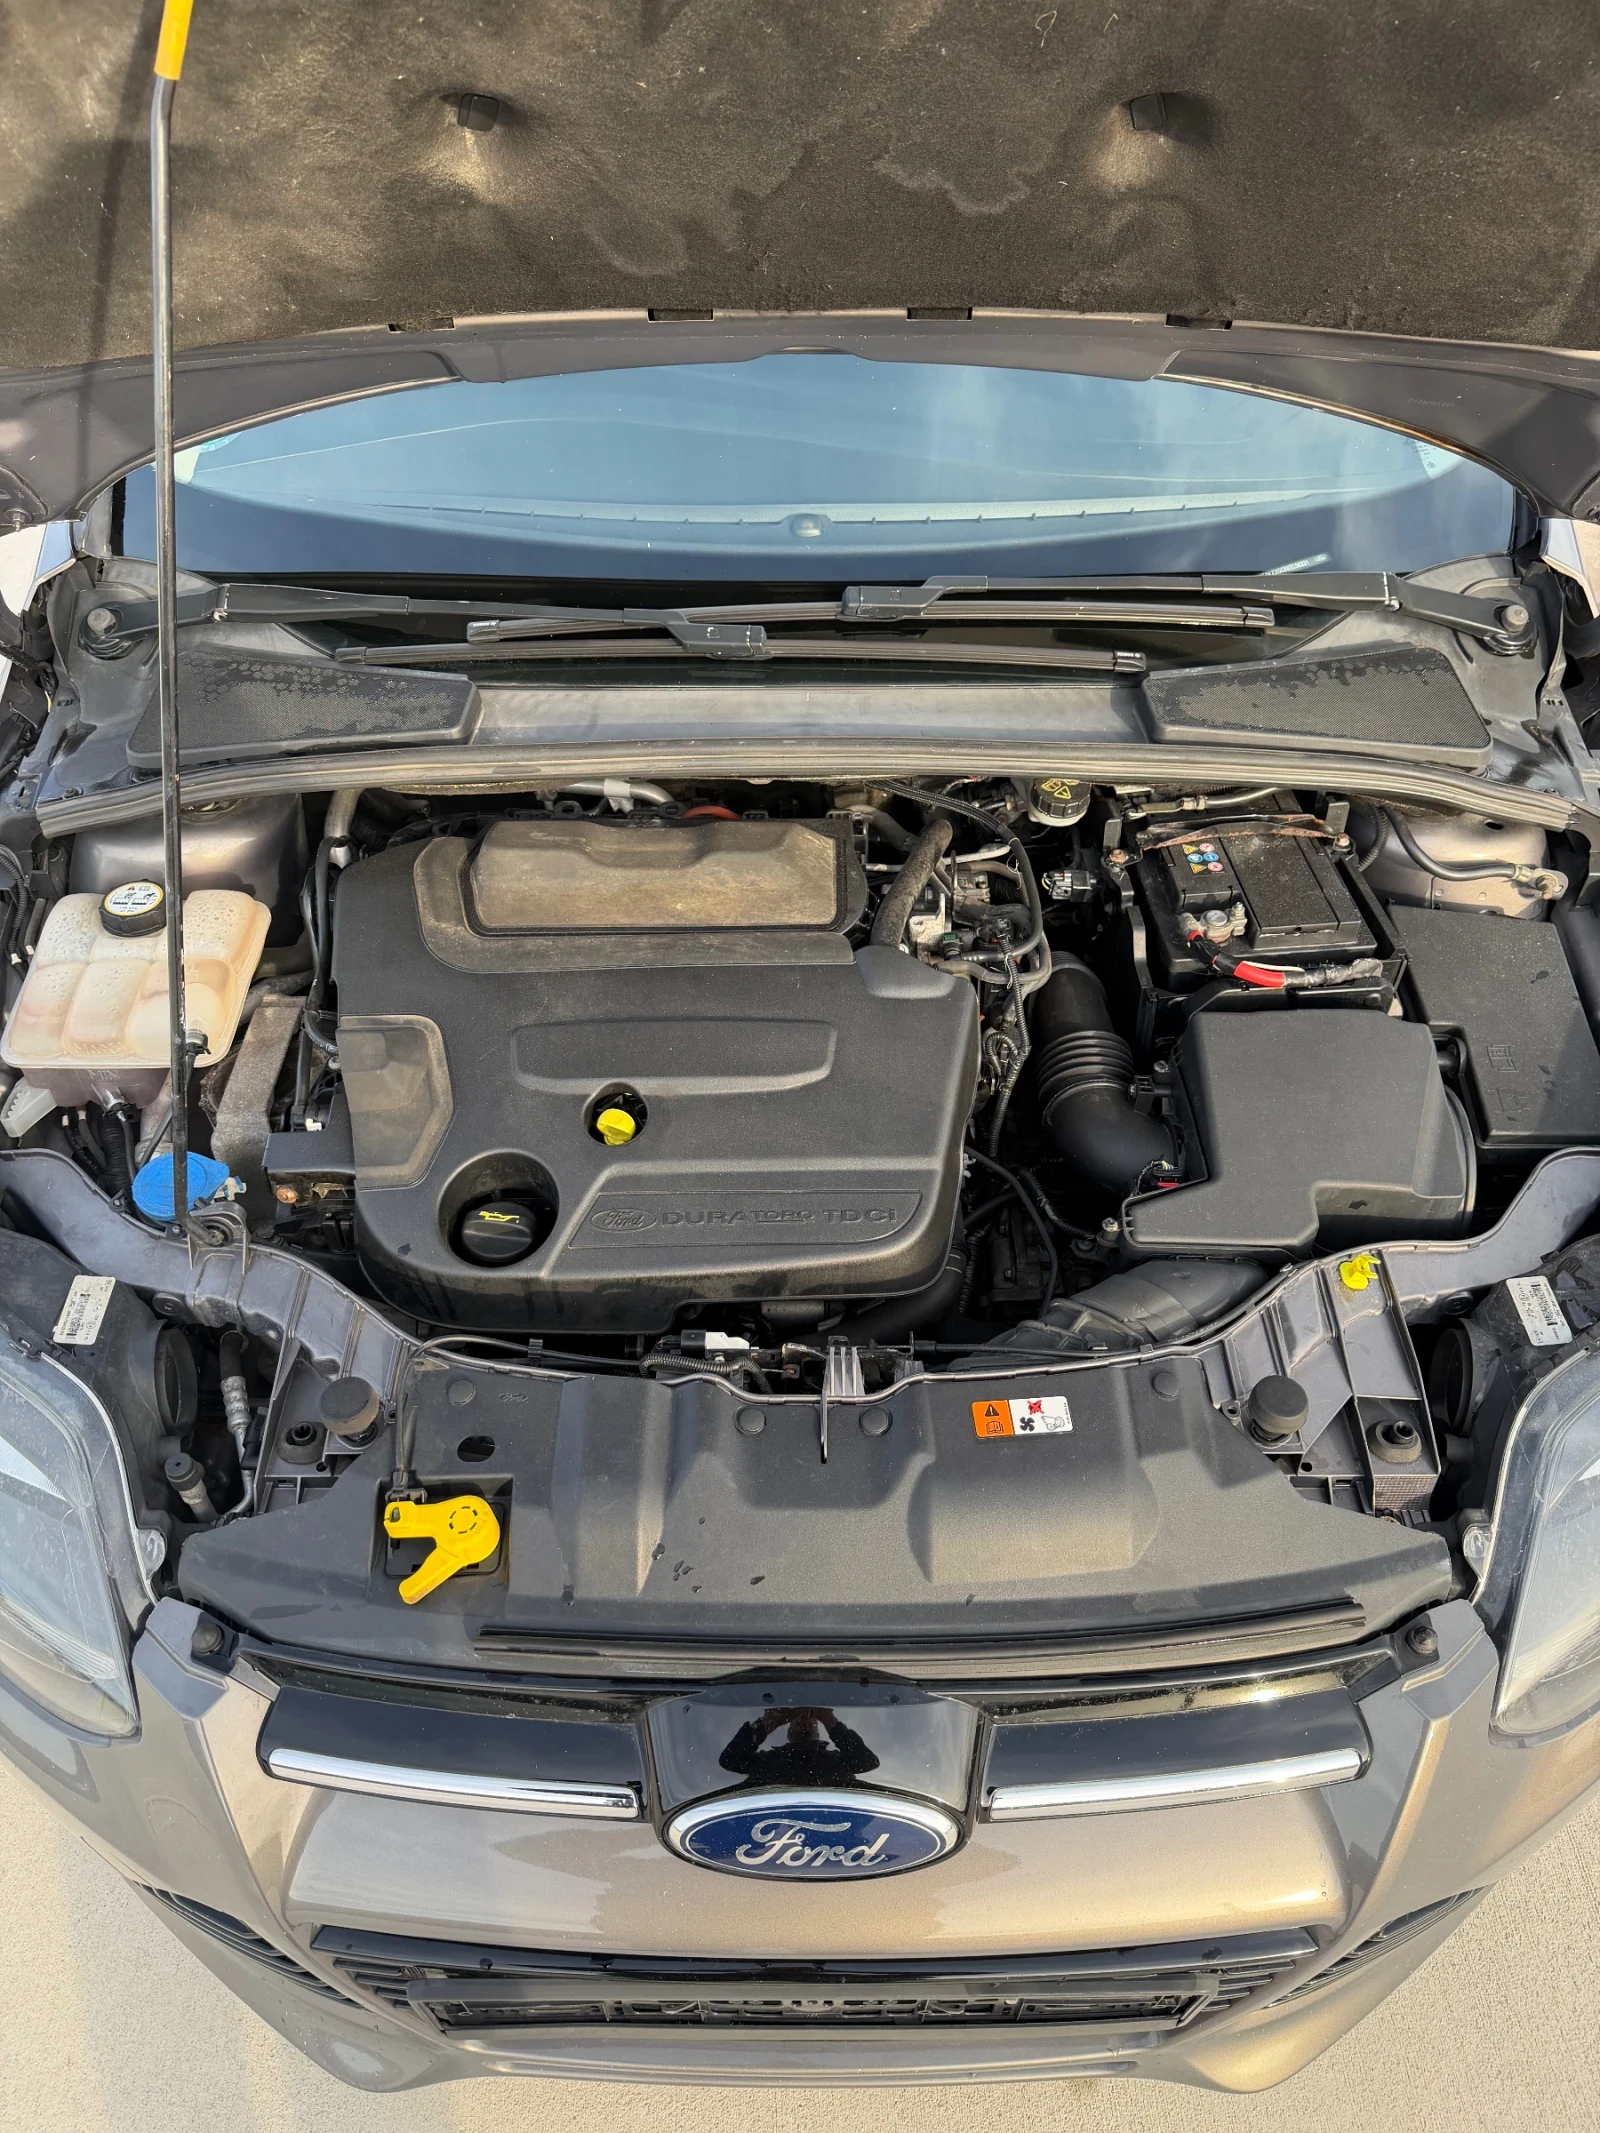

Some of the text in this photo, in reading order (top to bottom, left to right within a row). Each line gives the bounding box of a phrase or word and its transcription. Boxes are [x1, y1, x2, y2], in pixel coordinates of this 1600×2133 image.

[87, 1069, 120, 1081] MIN
[602, 1210, 645, 1229] Ford
[823, 1208, 897, 1225] TDCi
[735, 1817, 890, 1867] Ford
